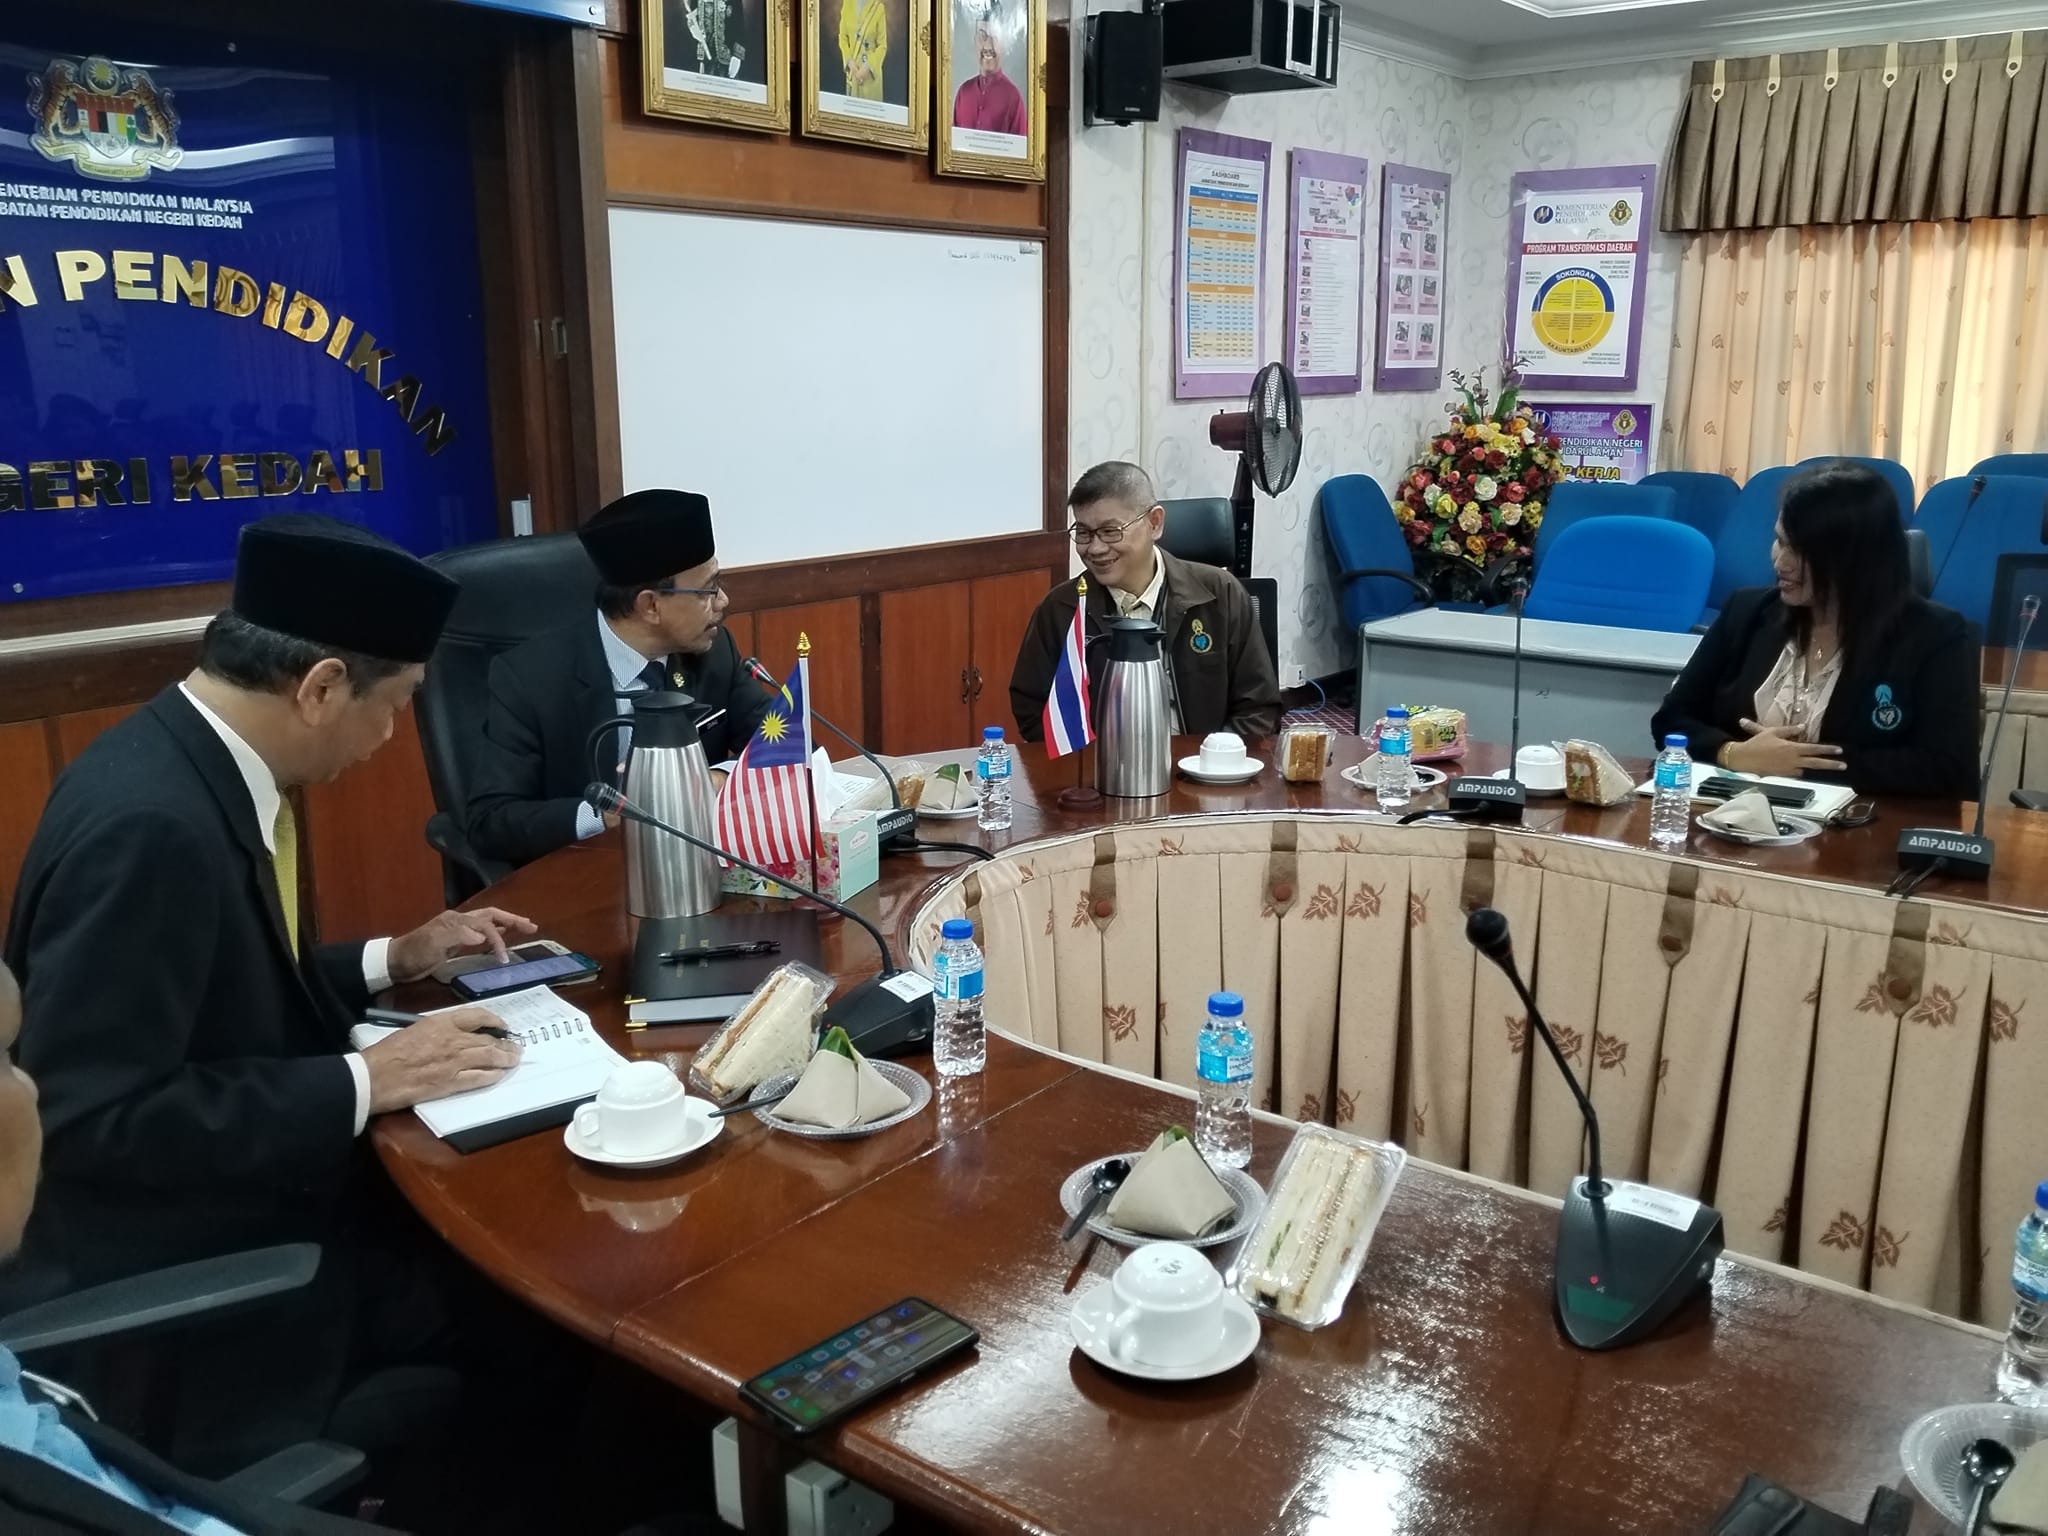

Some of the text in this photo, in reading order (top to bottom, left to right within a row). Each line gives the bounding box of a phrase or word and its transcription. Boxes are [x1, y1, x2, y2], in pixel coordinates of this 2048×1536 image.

[81, 188, 177, 208] PENDIDIKAN
[181, 199, 254, 215] MALAYSIA
[50, 205, 142, 224] PENDIDIKAN
[143, 210, 194, 227] NEGERI
[196, 212, 243, 230] KEDAH
[1526, 243, 1633, 254] PROGRAM TRANSFORMASI DAERAH
[1555, 269, 1596, 281] SOKONGAN
[55, 249, 457, 457] PENDIDIKAN
[1612, 439, 1643, 448] NEGERI
[1565, 446, 1593, 456] DARUL
[1594, 447, 1623, 457] AMAN
[170, 448, 384, 502] KEDAH
[1576, 466, 1620, 480] KERJA
